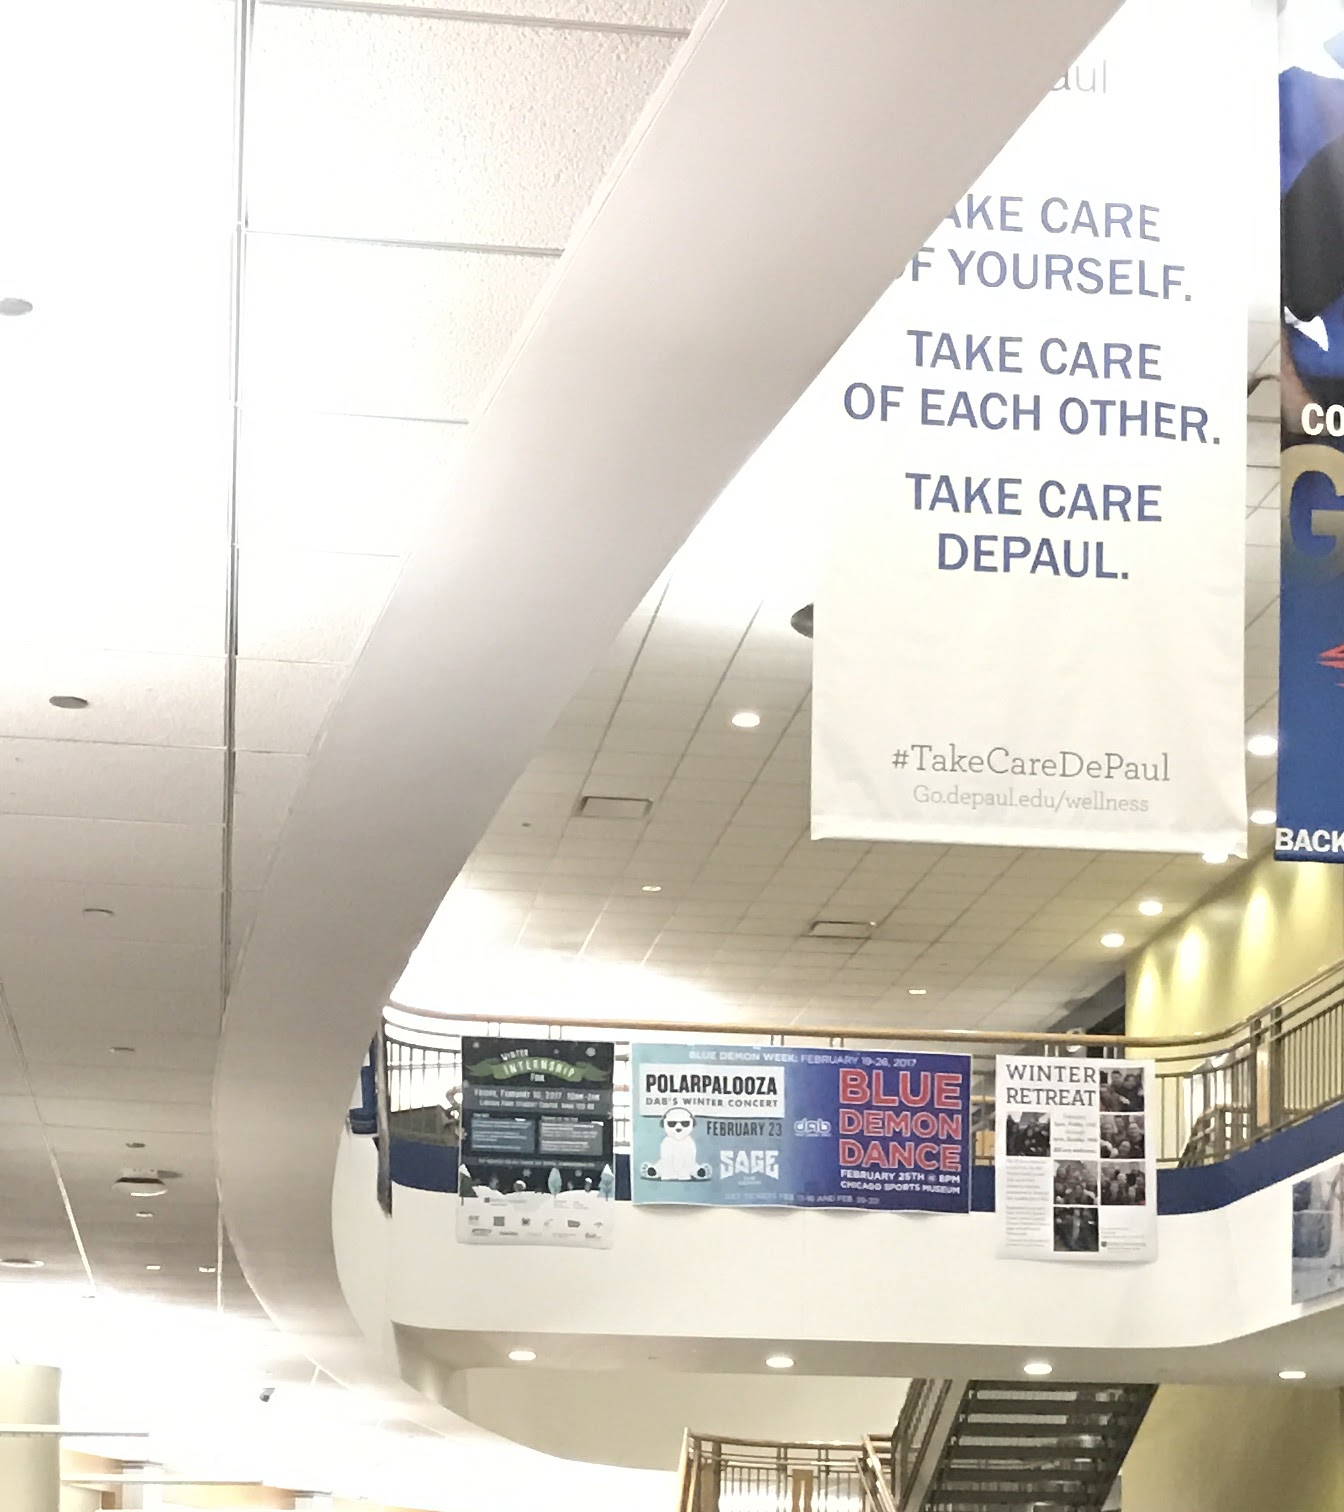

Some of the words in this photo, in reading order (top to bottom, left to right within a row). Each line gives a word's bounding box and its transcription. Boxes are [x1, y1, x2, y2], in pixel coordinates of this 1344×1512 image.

[1050, 59, 1107, 94] aul
[1040, 196, 1161, 243] CARE
[896, 246, 936, 282] F
[947, 248, 1192, 302] YOURSELF.
[906, 329, 1024, 374] TAKE
[1039, 337, 1162, 382] CARE
[843, 382, 905, 422] OF
[920, 387, 1041, 432] EACH
[1059, 396, 1221, 445] OTHER.
[905, 471, 1023, 516] TAKE
[1038, 479, 1163, 523] CARE
[937, 532, 1129, 580] DEPAUL.
[891, 743, 1171, 782] #TakeCareDePaul
[912, 784, 1150, 813] Go.depaul.edu/wellness
[502, 1059, 575, 1078] INTERNSHIP
[688, 1049, 717, 1060] BLUE
[720, 1050, 761, 1061] DEMON
[763, 1052, 799, 1063] WEEK:
[801, 1054, 859, 1066] FEBRUARY
[893, 1057, 917, 1068] 2017
[1005, 1063, 1097, 1084] WINTER
[645, 1073, 778, 1096] POLARPALOOZA
[838, 1067, 963, 1110] BLUE
[1006, 1087, 1097, 1107] RETREAT
[645, 1097, 679, 1106] DAB'S
[682, 1097, 724, 1107] WINTER
[728, 1099, 779, 1108] CONCERT
[706, 1120, 765, 1137] FEBRUARY
[768, 1121, 783, 1137] 23
[838, 1108, 962, 1140] DEMON
[719, 1149, 780, 1181] SAGE
[838, 1138, 962, 1172] DANCE
[840, 1169, 896, 1181] FEBRUARY
[897, 1171, 925, 1181] 25TH
[840, 1180, 882, 1191] CHICAGO
[883, 1182, 921, 1192] SPORTS
[921, 1184, 961, 1195] MUSEUM
